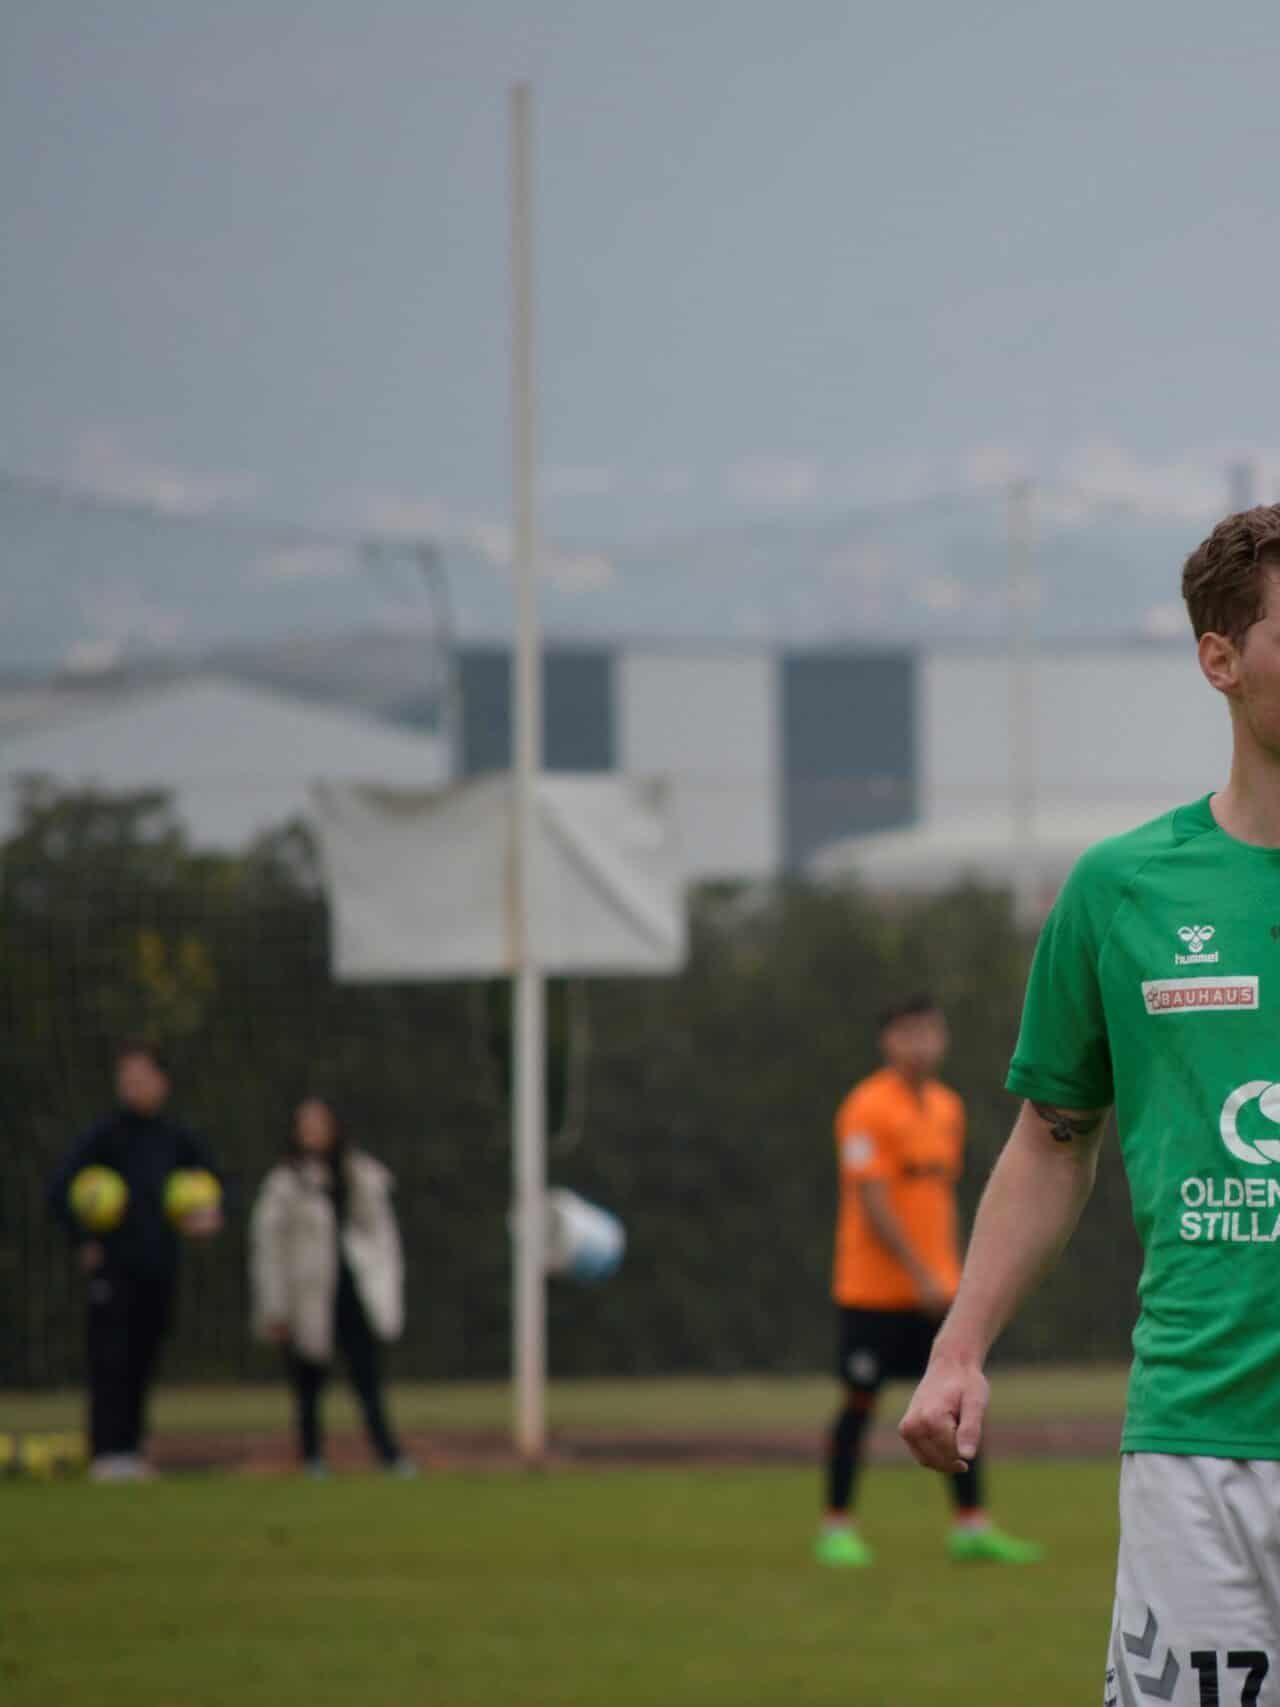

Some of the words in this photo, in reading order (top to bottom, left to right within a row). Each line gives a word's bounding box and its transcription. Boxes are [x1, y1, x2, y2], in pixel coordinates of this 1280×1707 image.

[1175, 951, 1219, 965] hummel
[1160, 987, 1253, 1007] BAUHAUS
[1190, 1651, 1269, 1707] 17
